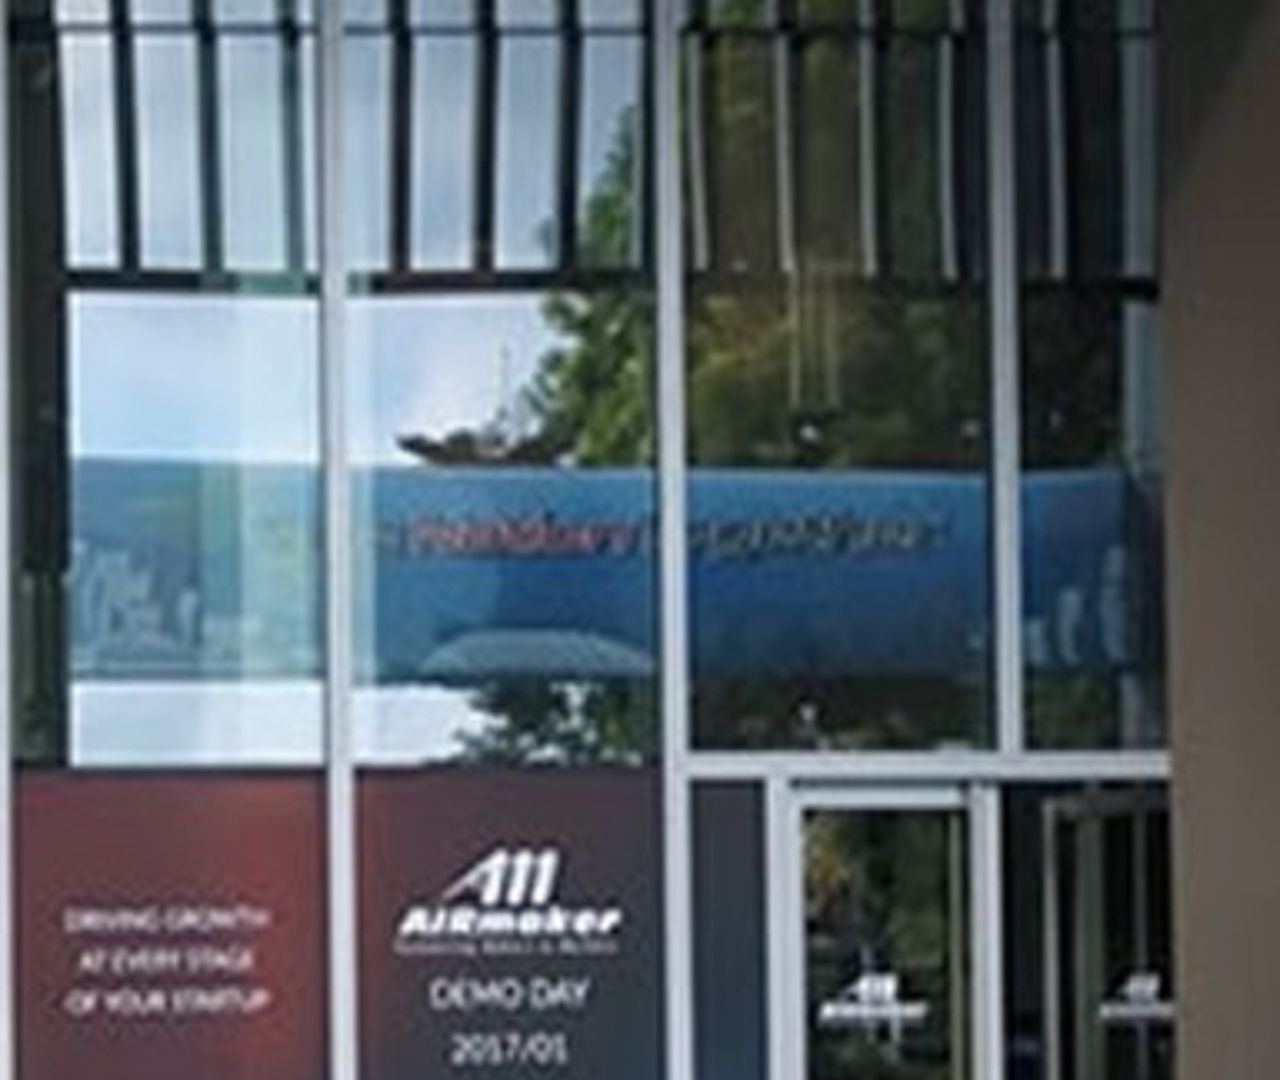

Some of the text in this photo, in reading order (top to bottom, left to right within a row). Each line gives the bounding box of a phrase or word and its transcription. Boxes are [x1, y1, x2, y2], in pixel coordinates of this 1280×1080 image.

[64, 905, 271, 933] DRIVING GROWTH
[397, 904, 623, 935] AIRmaker
[80, 947, 255, 976] AT EVERY STAGE
[63, 986, 272, 1015] OF YOUR STARTUP
[428, 976, 591, 1012] DEMO DAY
[451, 1032, 568, 1066] 2017/01
